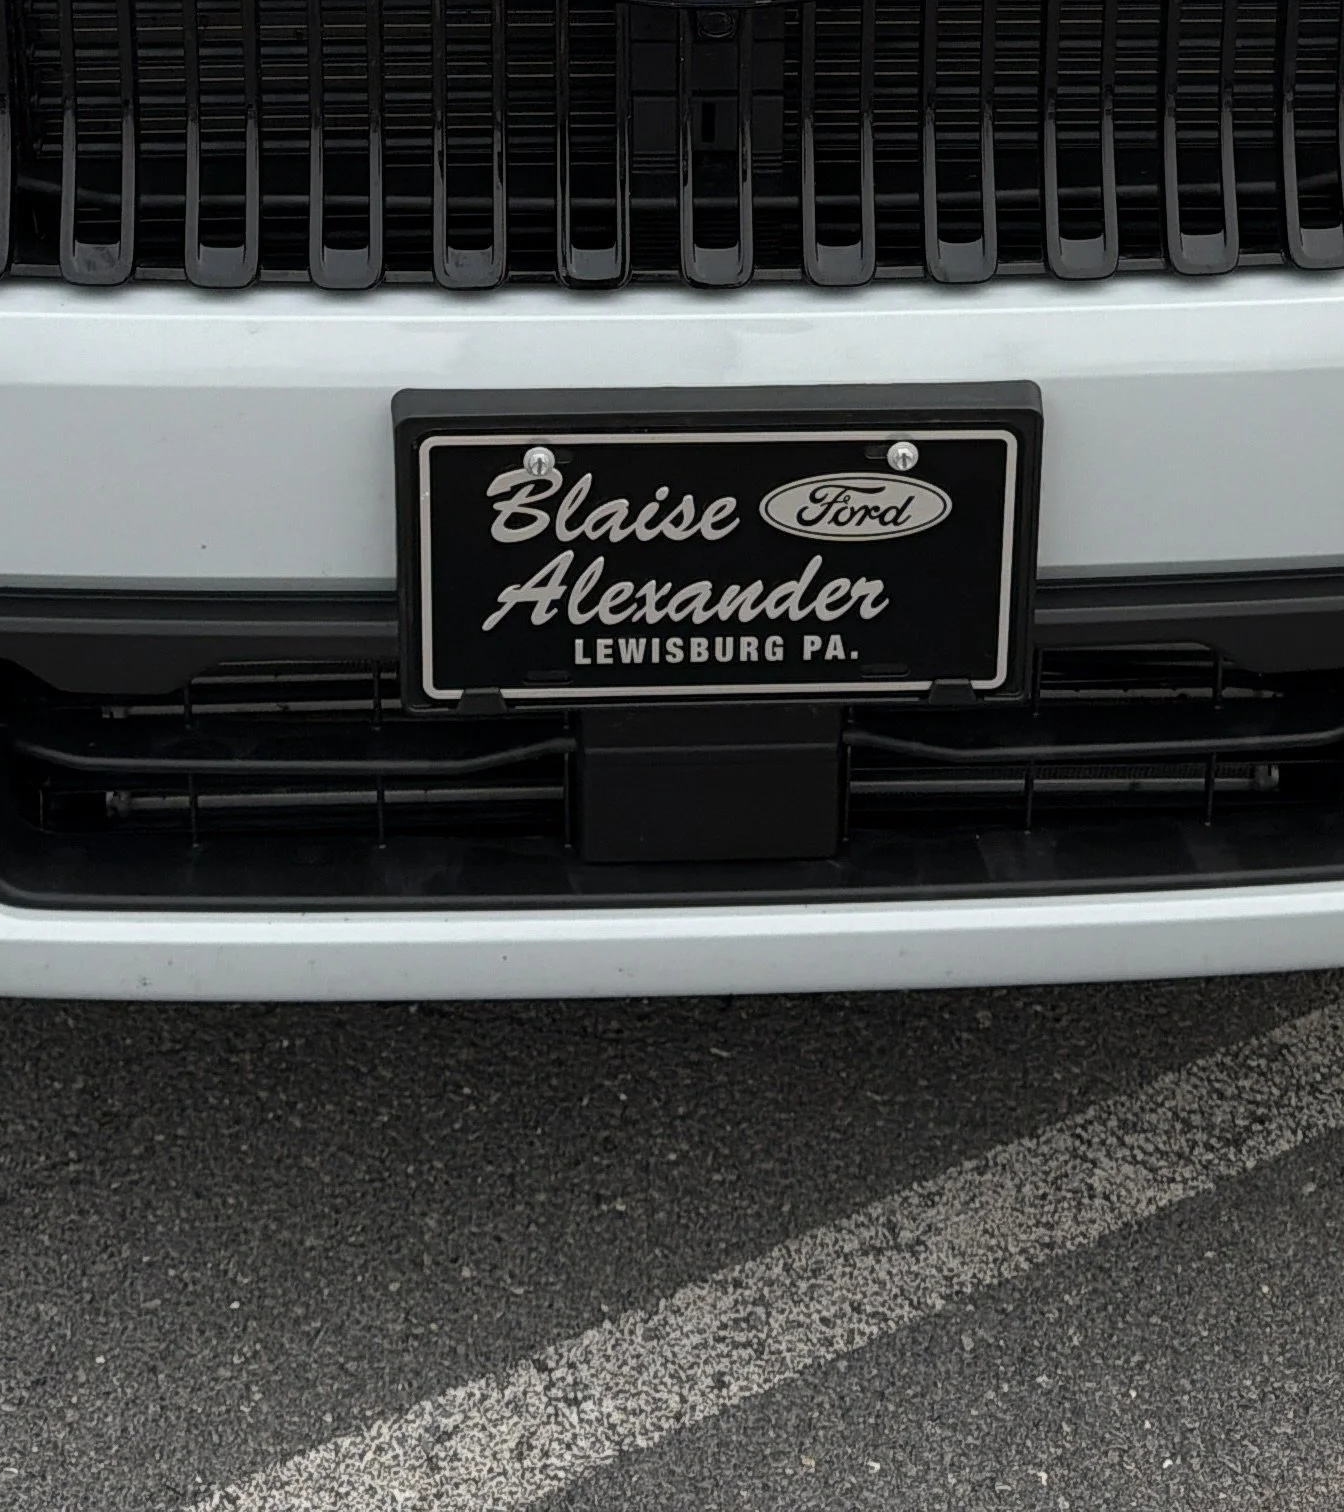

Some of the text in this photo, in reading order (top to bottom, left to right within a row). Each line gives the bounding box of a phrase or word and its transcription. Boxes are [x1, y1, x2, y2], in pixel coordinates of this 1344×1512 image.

[486, 466, 916, 543] Blaise Ford
[482, 549, 890, 631] Alexander
[574, 634, 859, 665] LEWISBURG PA.
